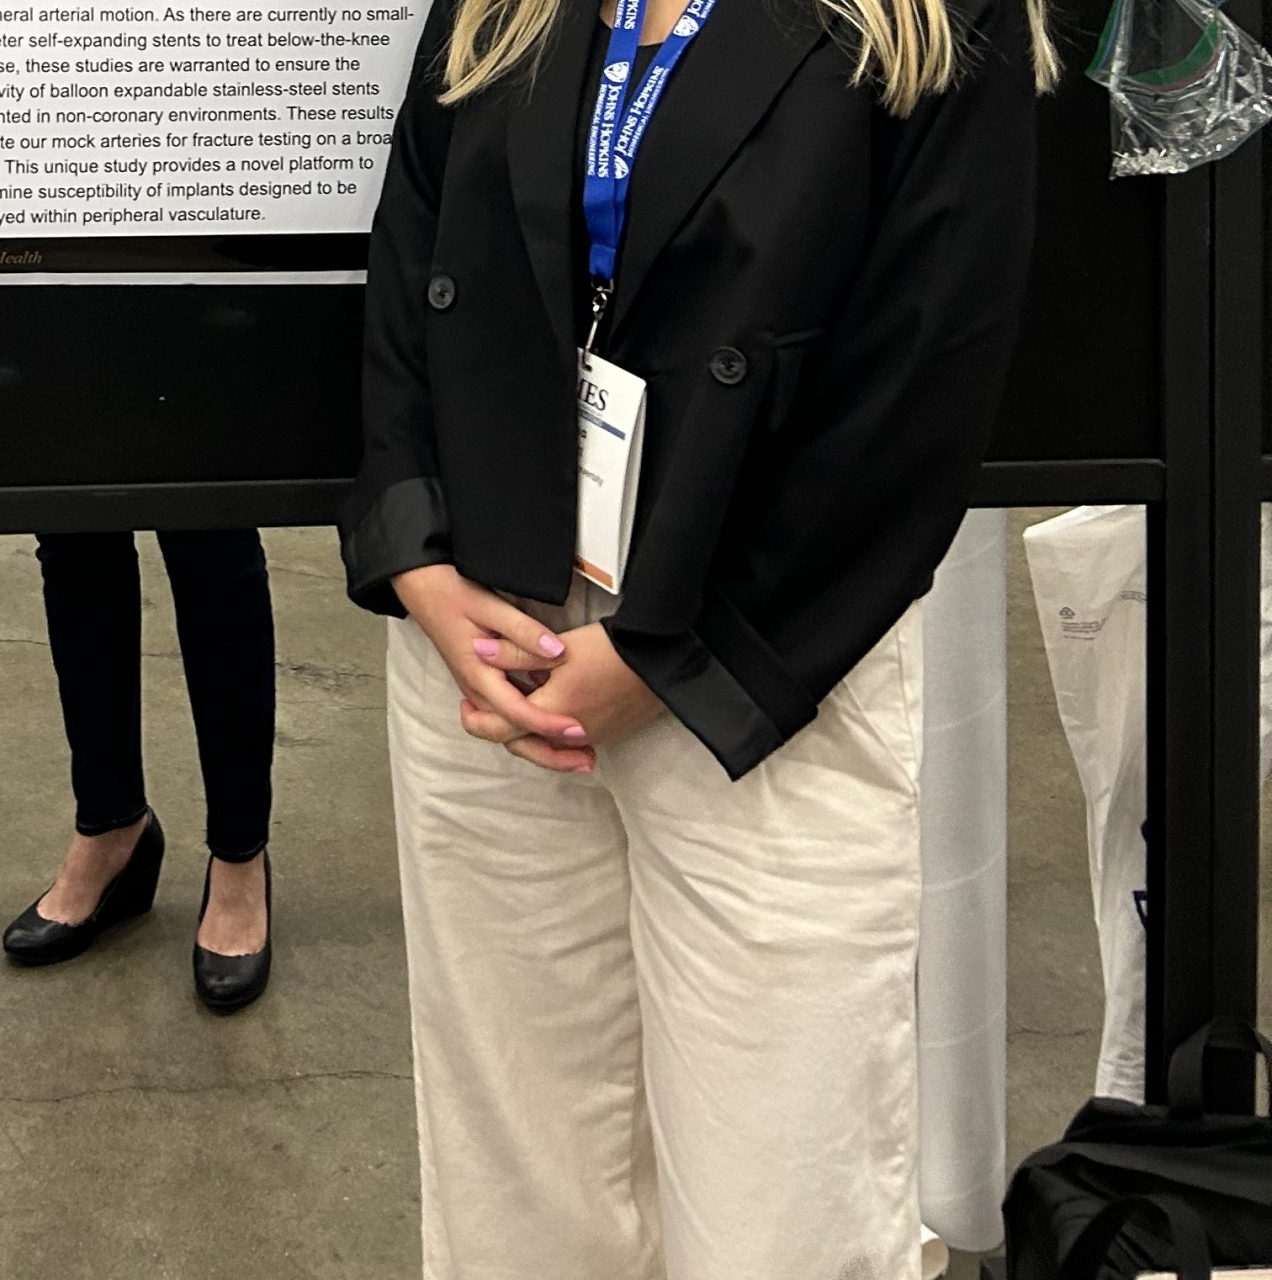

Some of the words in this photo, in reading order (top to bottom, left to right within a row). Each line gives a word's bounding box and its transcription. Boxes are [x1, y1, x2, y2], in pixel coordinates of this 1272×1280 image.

[604, 85, 622, 120] JOHNS
[614, 116, 638, 157] JOHNS
[630, 65, 664, 116] HOPKINS
[598, 123, 614, 178] HOPKINS
